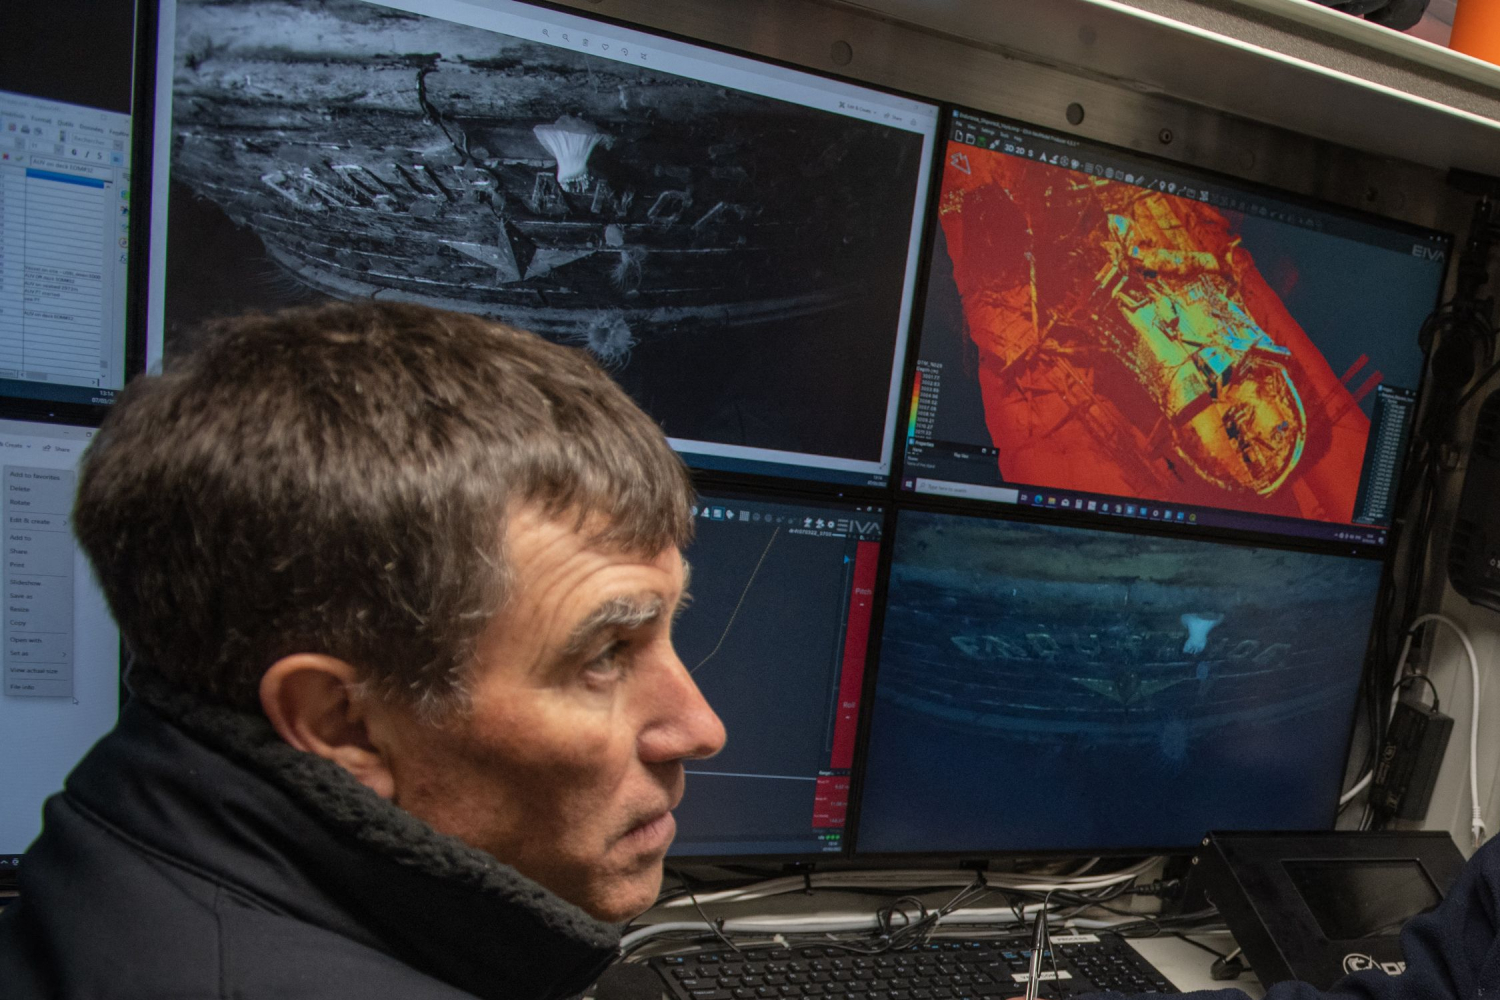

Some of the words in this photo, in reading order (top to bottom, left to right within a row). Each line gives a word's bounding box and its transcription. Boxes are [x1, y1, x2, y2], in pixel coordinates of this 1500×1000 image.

[1412, 243, 1445, 262] EIVA
[33, 473, 60, 481] favorites
[837, 519, 882, 534] EIVA
